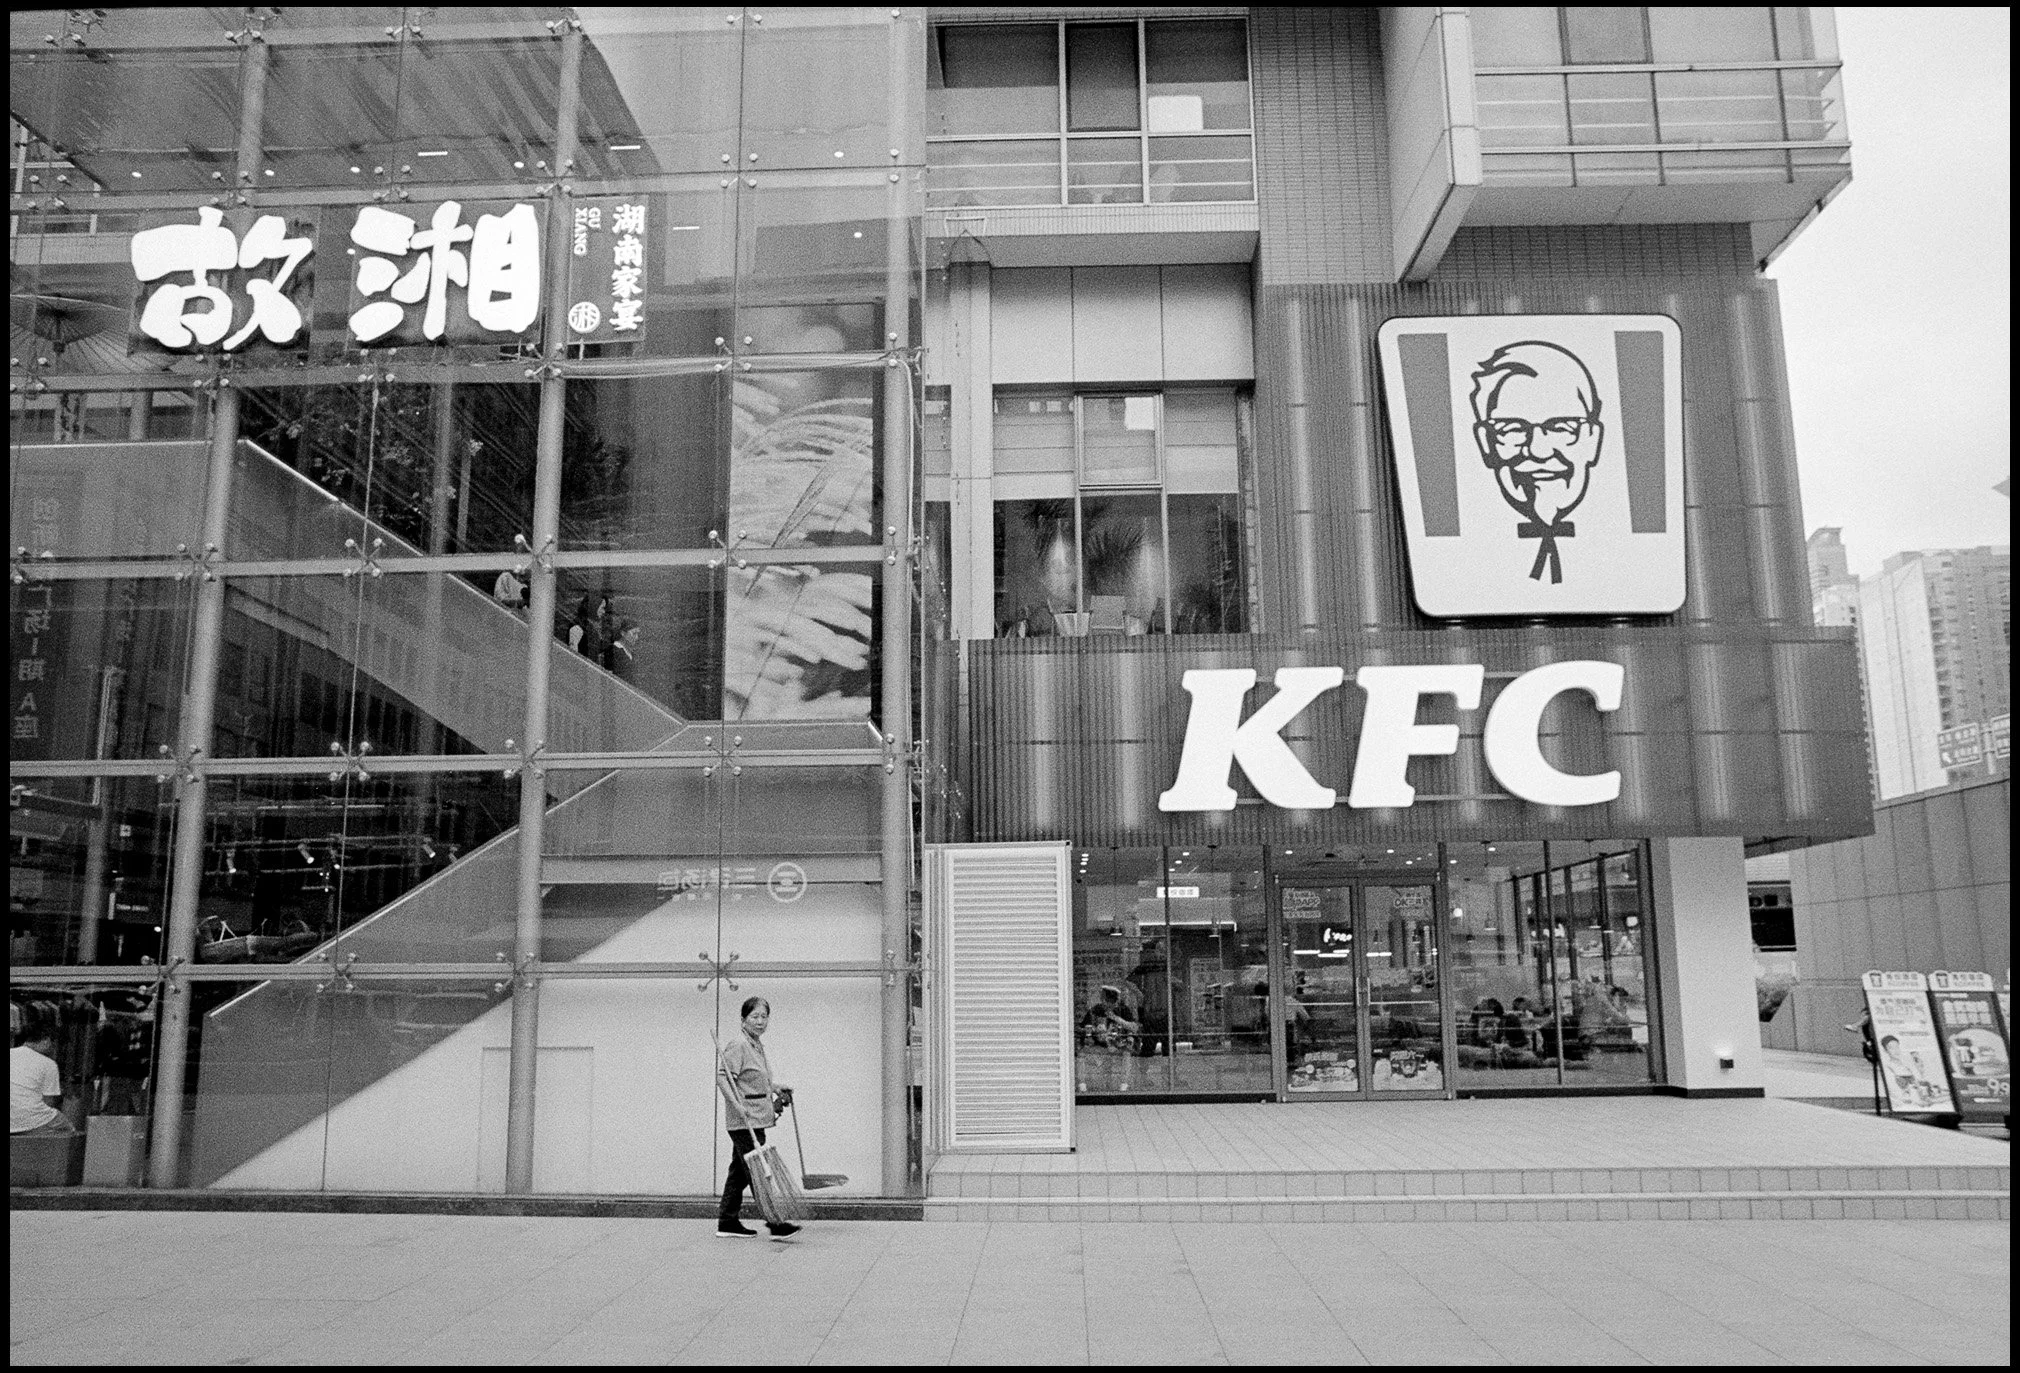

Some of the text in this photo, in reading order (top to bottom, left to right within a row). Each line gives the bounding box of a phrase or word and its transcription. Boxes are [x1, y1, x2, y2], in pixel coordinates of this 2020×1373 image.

[132, 201, 539, 349] 故湘
[574, 207, 588, 256] XIANG
[588, 206, 602, 230] GU
[609, 203, 646, 331] 湖南家宴
[1159, 661, 1623, 810] KFC
